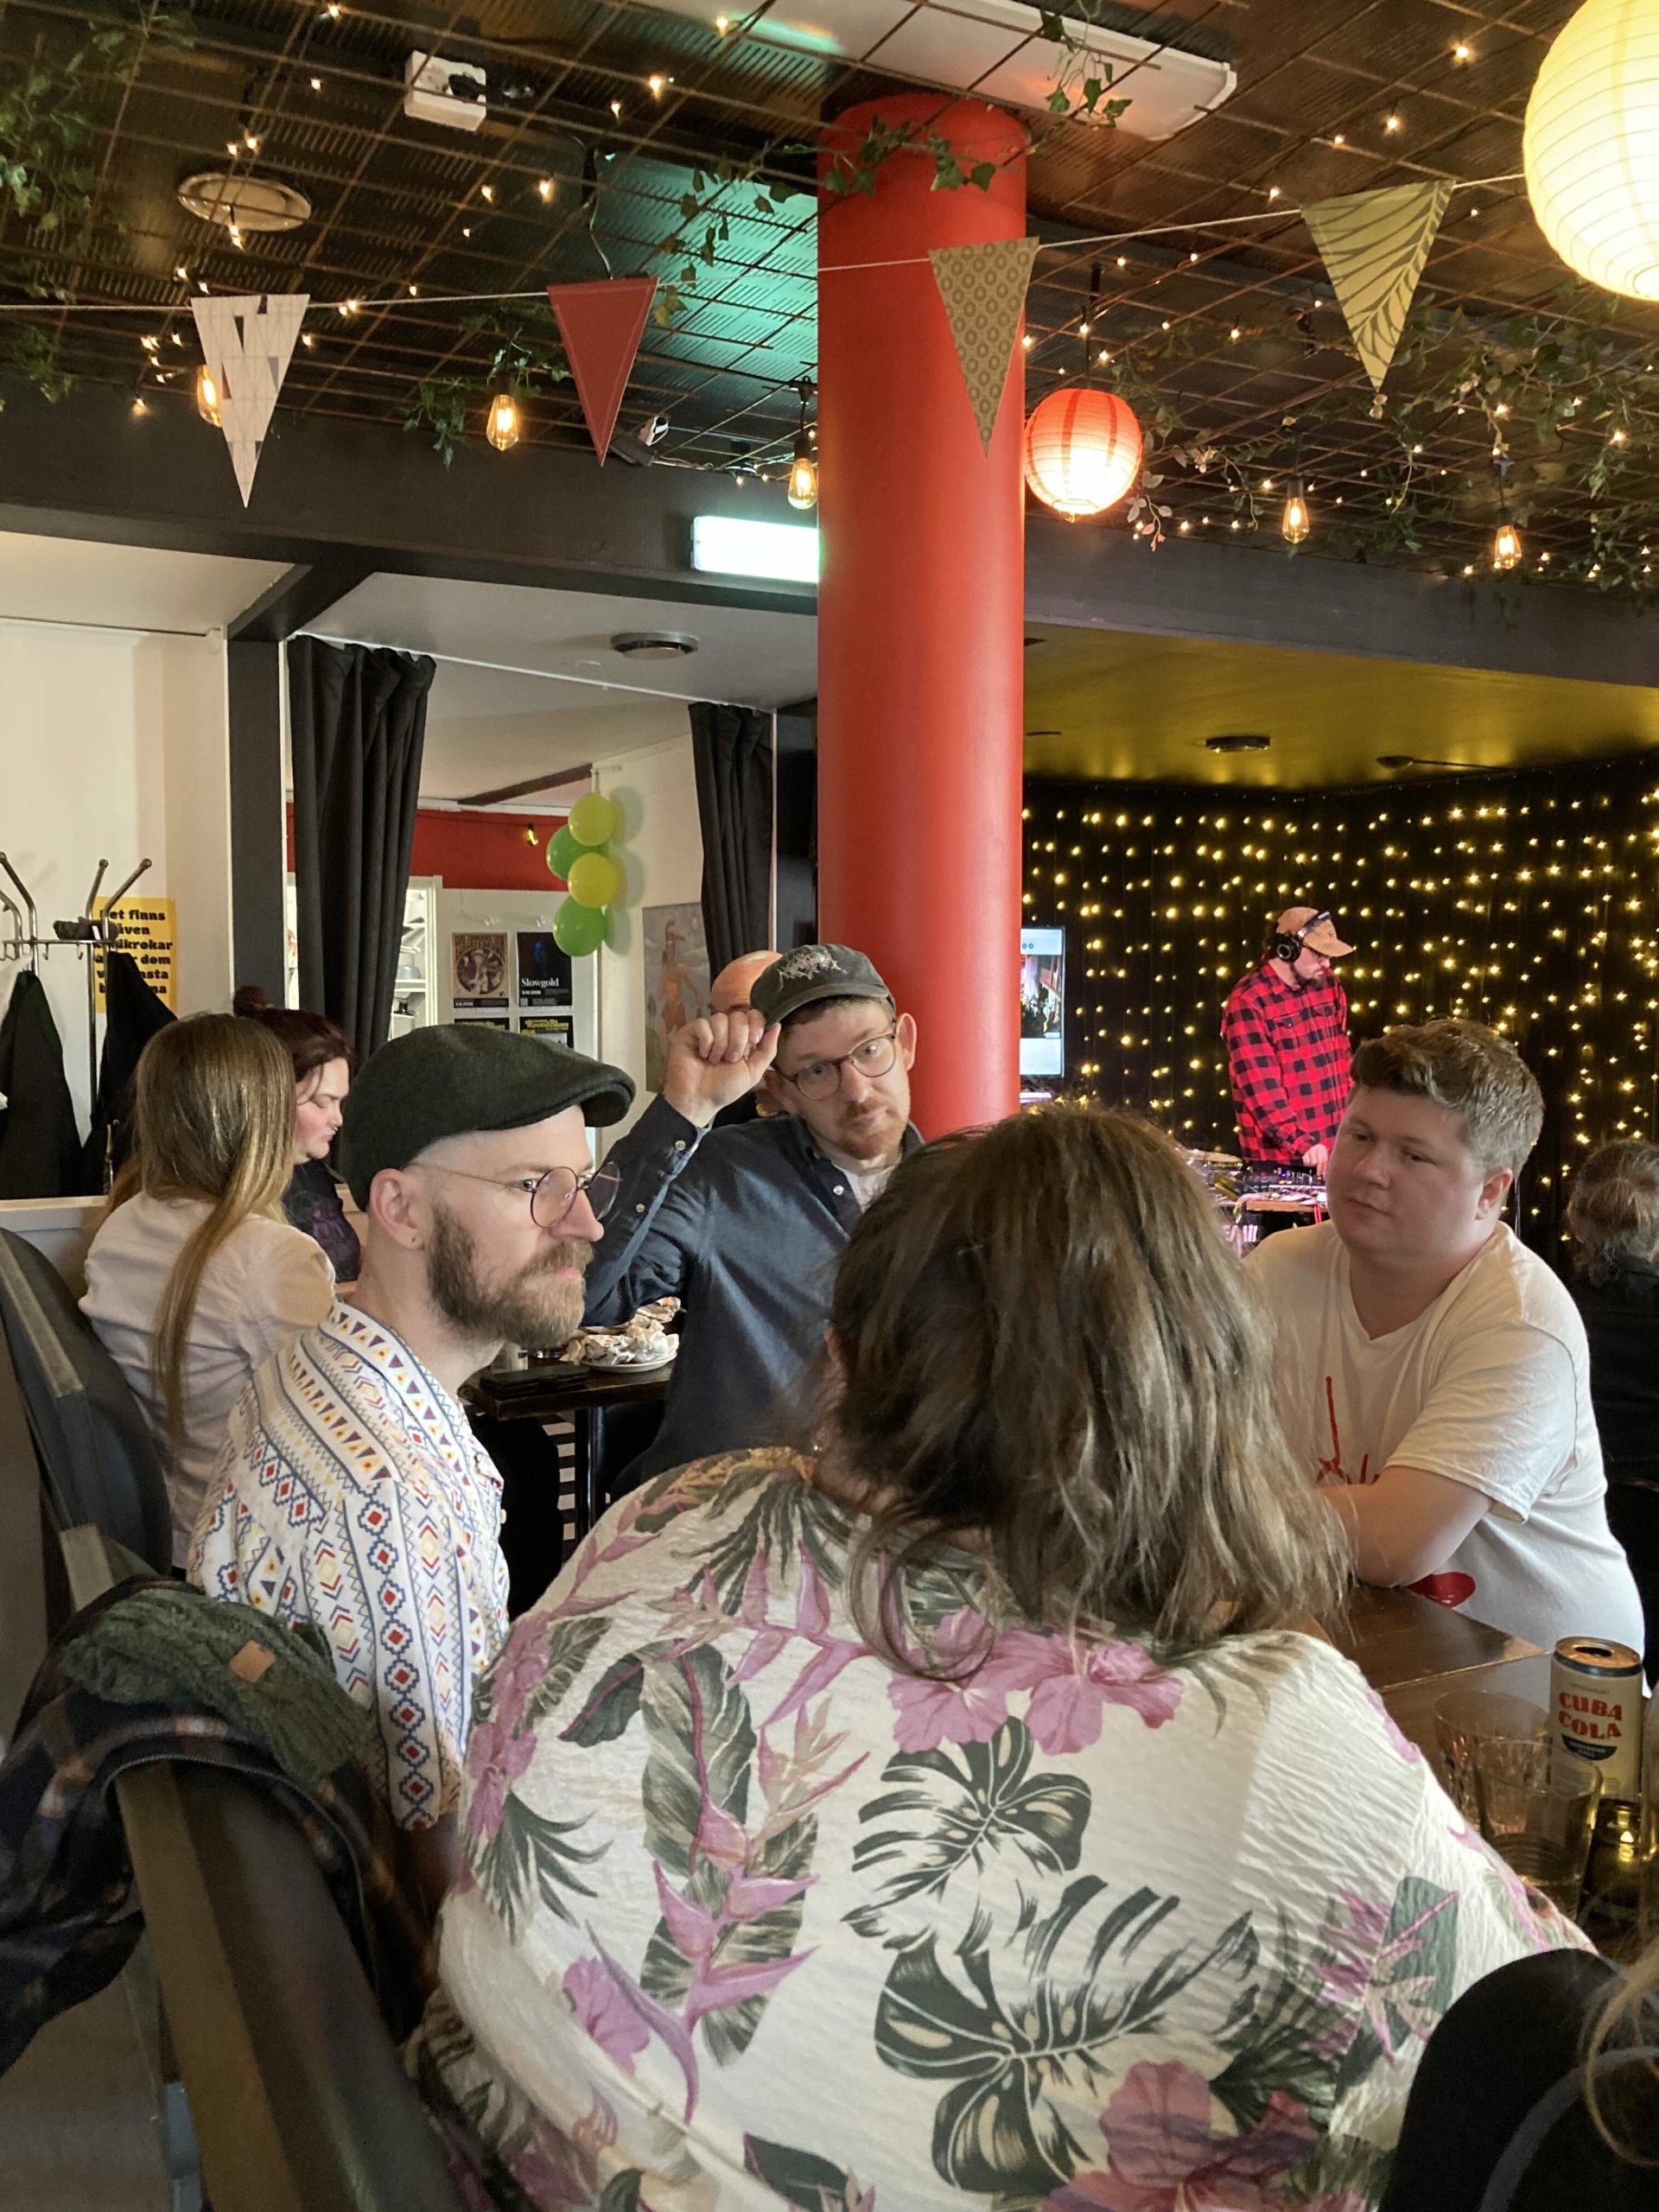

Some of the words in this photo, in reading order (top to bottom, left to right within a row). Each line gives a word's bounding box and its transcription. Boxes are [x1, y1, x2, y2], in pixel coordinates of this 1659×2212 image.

[129, 909, 166, 920] finns
[140, 954, 171, 964] dom
[521, 977, 559, 988] Slowgold
[1559, 1691, 1622, 1720] CUBA
[1558, 1710, 1623, 1739] COLA
